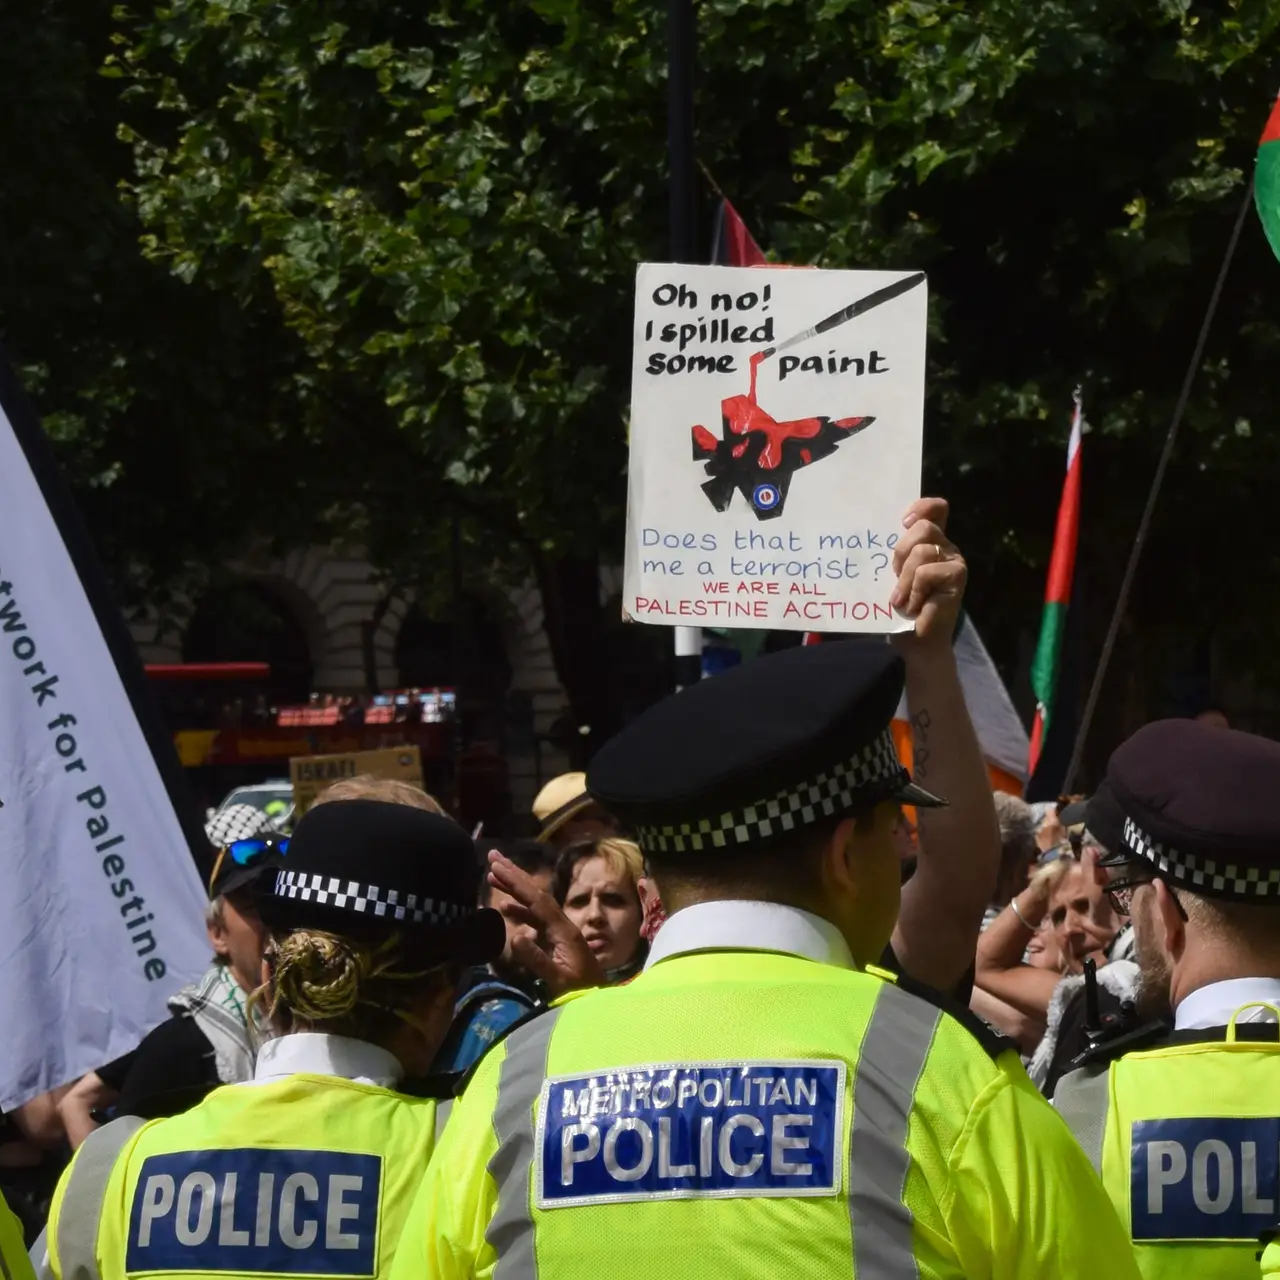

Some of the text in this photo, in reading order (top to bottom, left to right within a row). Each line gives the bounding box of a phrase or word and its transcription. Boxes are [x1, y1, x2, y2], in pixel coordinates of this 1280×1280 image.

[652, 283, 772, 312] Oh no!
[645, 316, 775, 352] I spilled
[645, 350, 890, 381] some paint
[642, 528, 899, 551] Does that make
[642, 558, 685, 576] me
[697, 560, 715, 576] a
[730, 556, 860, 579] terrorist
[702, 581, 826, 596] WE ARE ALL
[635, 596, 893, 621] PALESTINE ACTION
[47, 712, 87, 773] for
[76, 784, 168, 982] Palestine
[561, 1077, 817, 1118] METROPOLITAN
[560, 1113, 813, 1187] POLICE
[137, 1171, 364, 1250] POLICE
